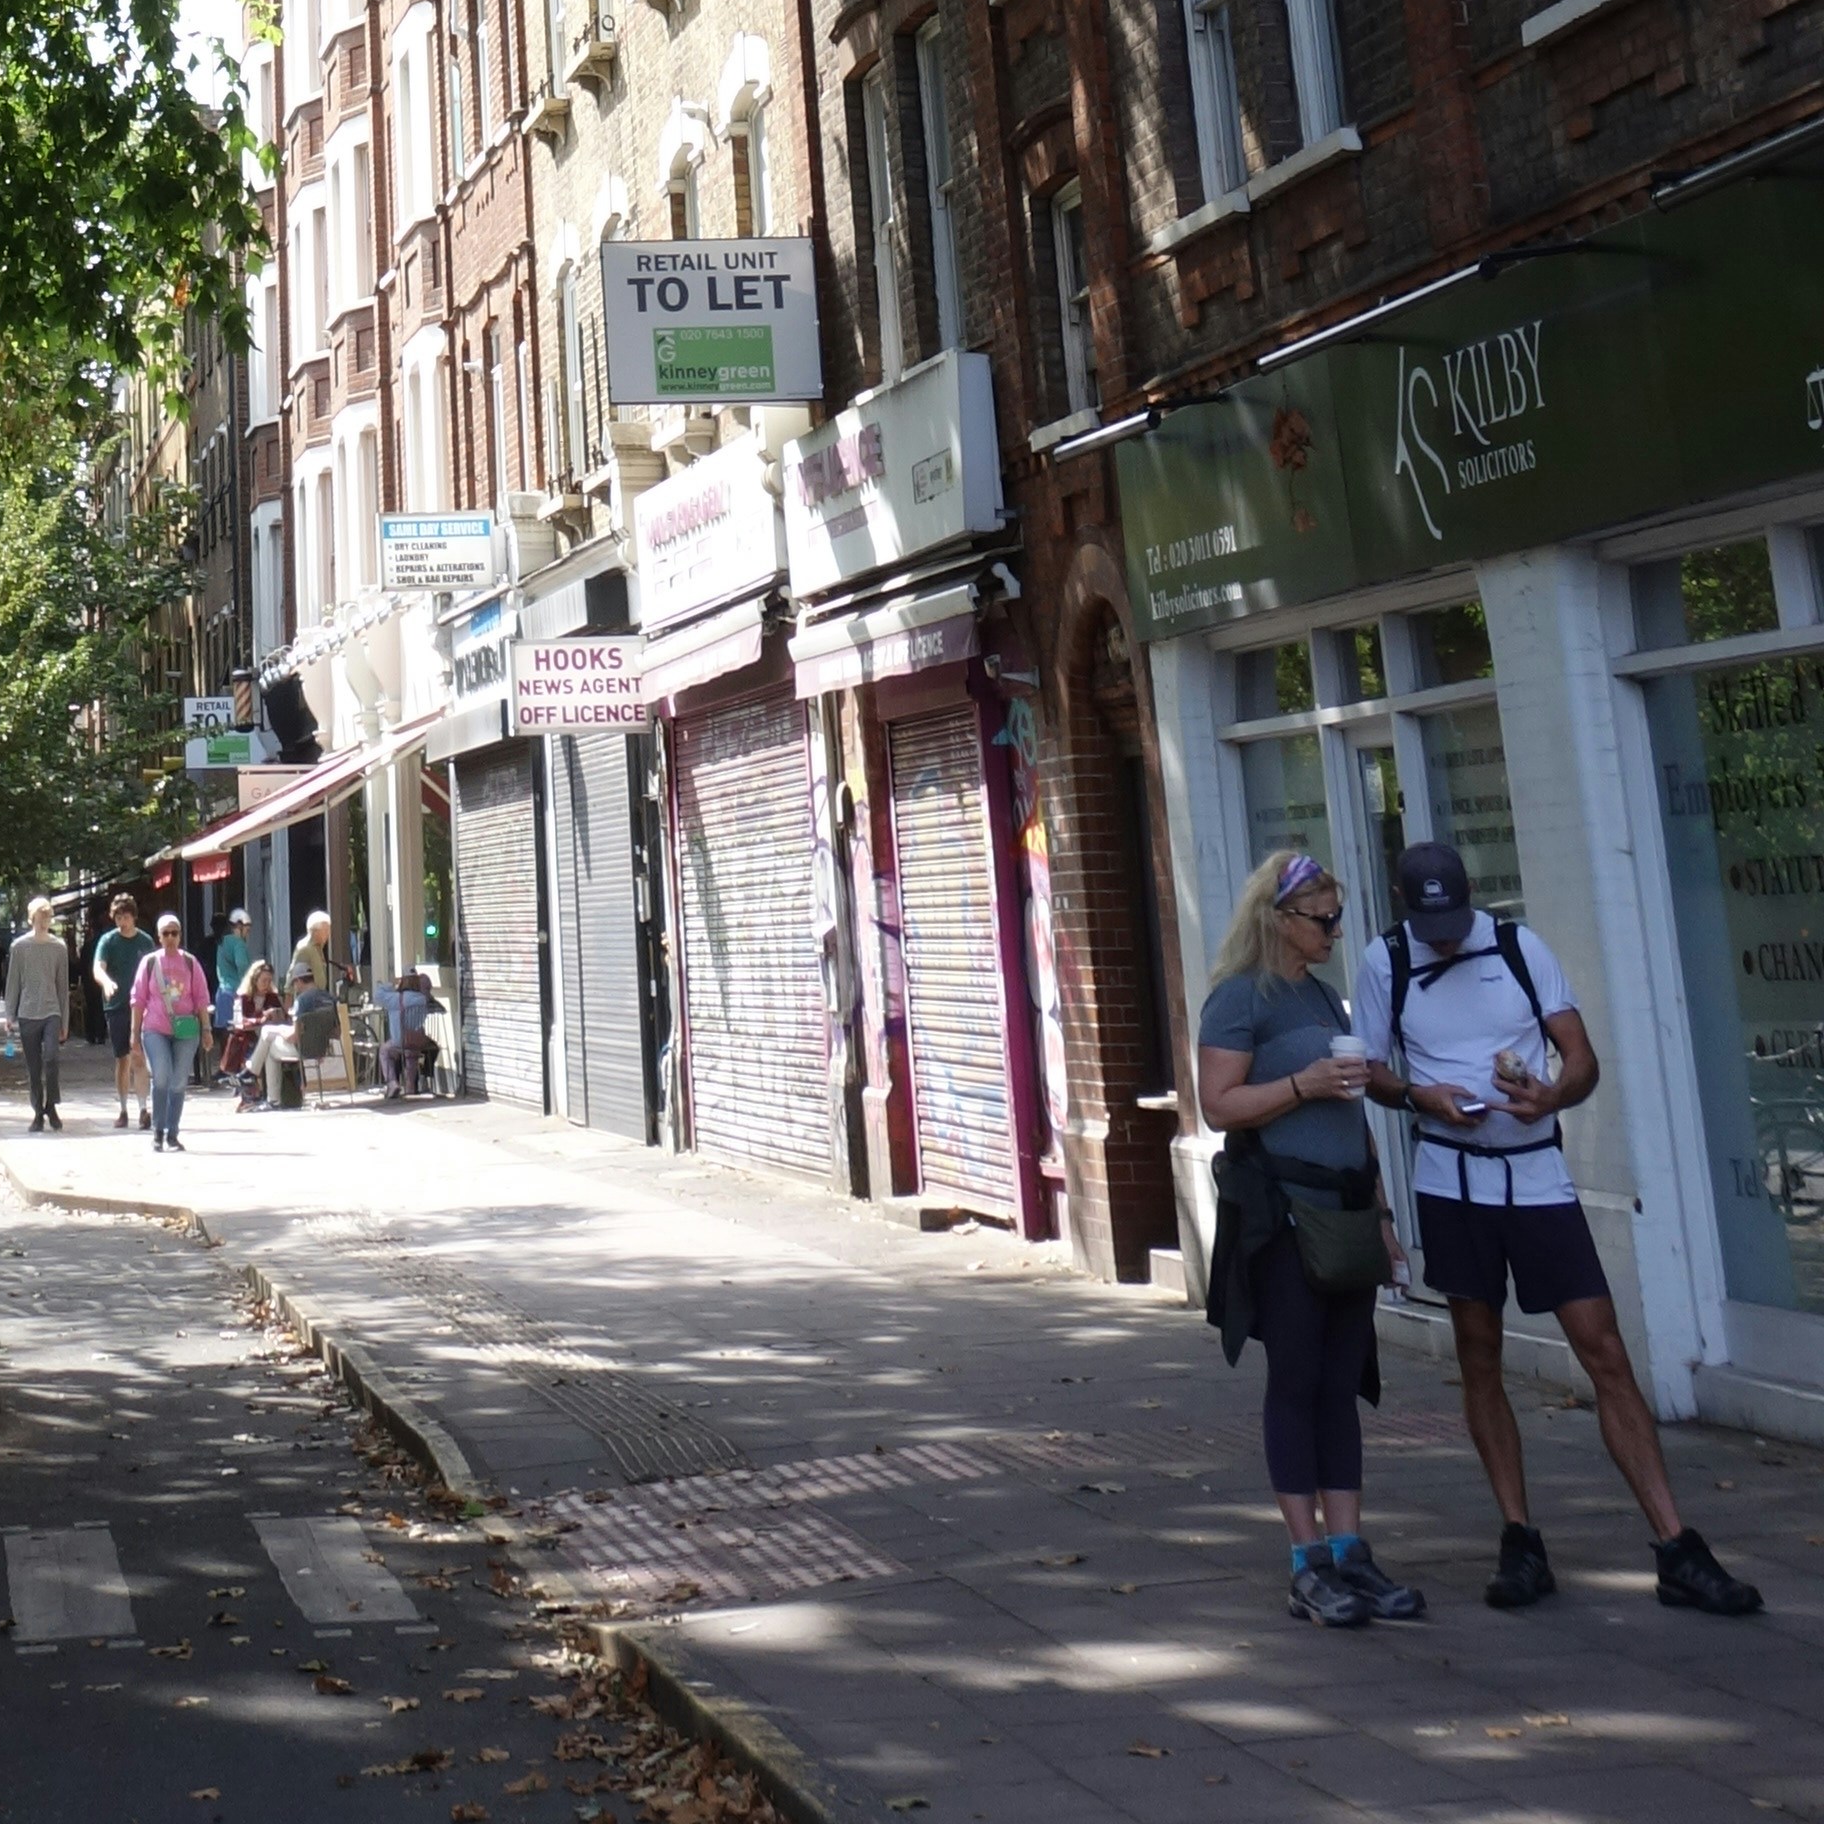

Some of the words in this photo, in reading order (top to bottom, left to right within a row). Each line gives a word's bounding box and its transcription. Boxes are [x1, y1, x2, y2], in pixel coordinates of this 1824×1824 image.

[637, 253, 716, 272] RETAIL
[724, 252, 778, 270] UNIT
[627, 277, 689, 312] TO
[707, 274, 791, 311] LET
[680, 330, 702, 341] 020
[737, 327, 764, 339] 1500
[658, 363, 771, 382] kinneygreen
[1442, 319, 1546, 445] KILBY
[660, 381, 772, 392] www.kinneygreen.com
[1457, 439, 1537, 490] SOLICITORS
[388, 523, 418, 537] SAME
[418, 522, 440, 536] DAY
[440, 521, 485, 536] SERVICE
[394, 543, 409, 551] DRY
[411, 541, 447, 550] CLEANING
[395, 553, 429, 562] LAUNDRY
[396, 563, 427, 573] REPAIRS
[436, 562, 485, 572] ALTERATIONS
[396, 575, 416, 584] SHOE
[442, 573, 474, 583] REPAIRS
[1150, 582, 1243, 624] kilbysolicitors.com
[534, 647, 624, 671] HOOKS
[518, 678, 574, 696] NEWS
[579, 676, 642, 694] AGENT
[196, 701, 231, 711] RETAIL
[519, 706, 557, 725] OFF
[562, 704, 647, 723] LICENCE
